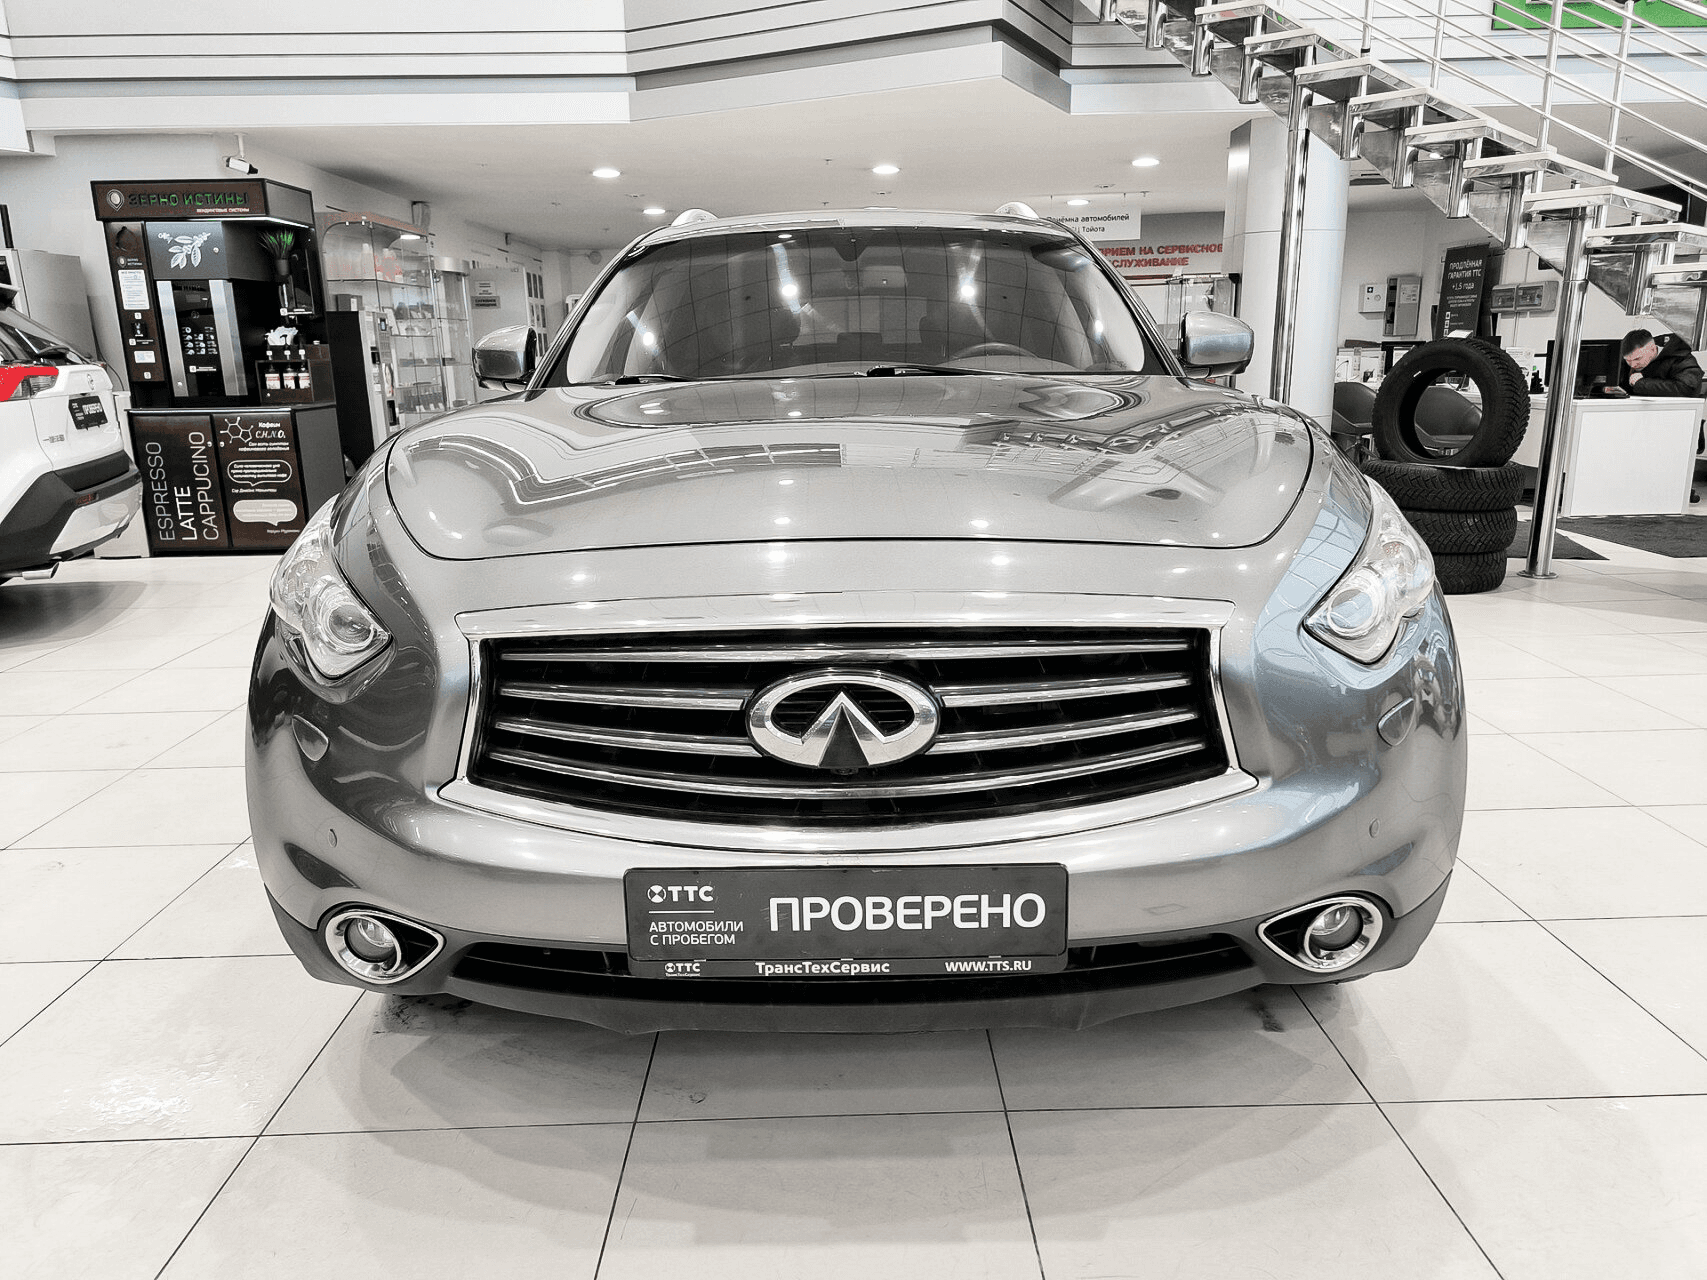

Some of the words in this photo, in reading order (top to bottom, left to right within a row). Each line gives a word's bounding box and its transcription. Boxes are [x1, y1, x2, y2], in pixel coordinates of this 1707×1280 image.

[128, 192, 179, 207] ЗЕРНО
[183, 191, 249, 206] ИСТИНЫ
[1081, 213, 1130, 223] автомобилей
[1139, 246, 1155, 256] НА
[1157, 243, 1223, 255] СЕРВИСНОЕ
[1109, 257, 1190, 268] СЛУЖИВАНИЕ
[1448, 270, 1472, 279] ГАРАНТИЯ
[146, 442, 176, 541] ESPRESSO
[189, 431, 219, 541] CAPPUCINO
[174, 486, 198, 541] LATTE
[667, 885, 714, 902] ТТС
[769, 892, 1046, 931] ПРОВЕРЕНО
[649, 921, 744, 933] АВТОМОБИЛИ
[650, 934, 659, 946] С
[662, 933, 736, 945] ПРОБЕГОМ
[675, 963, 701, 972] ТТС
[755, 961, 890, 976] ТрансТехСервис
[945, 960, 1032, 972] WWW.TTS.RU
